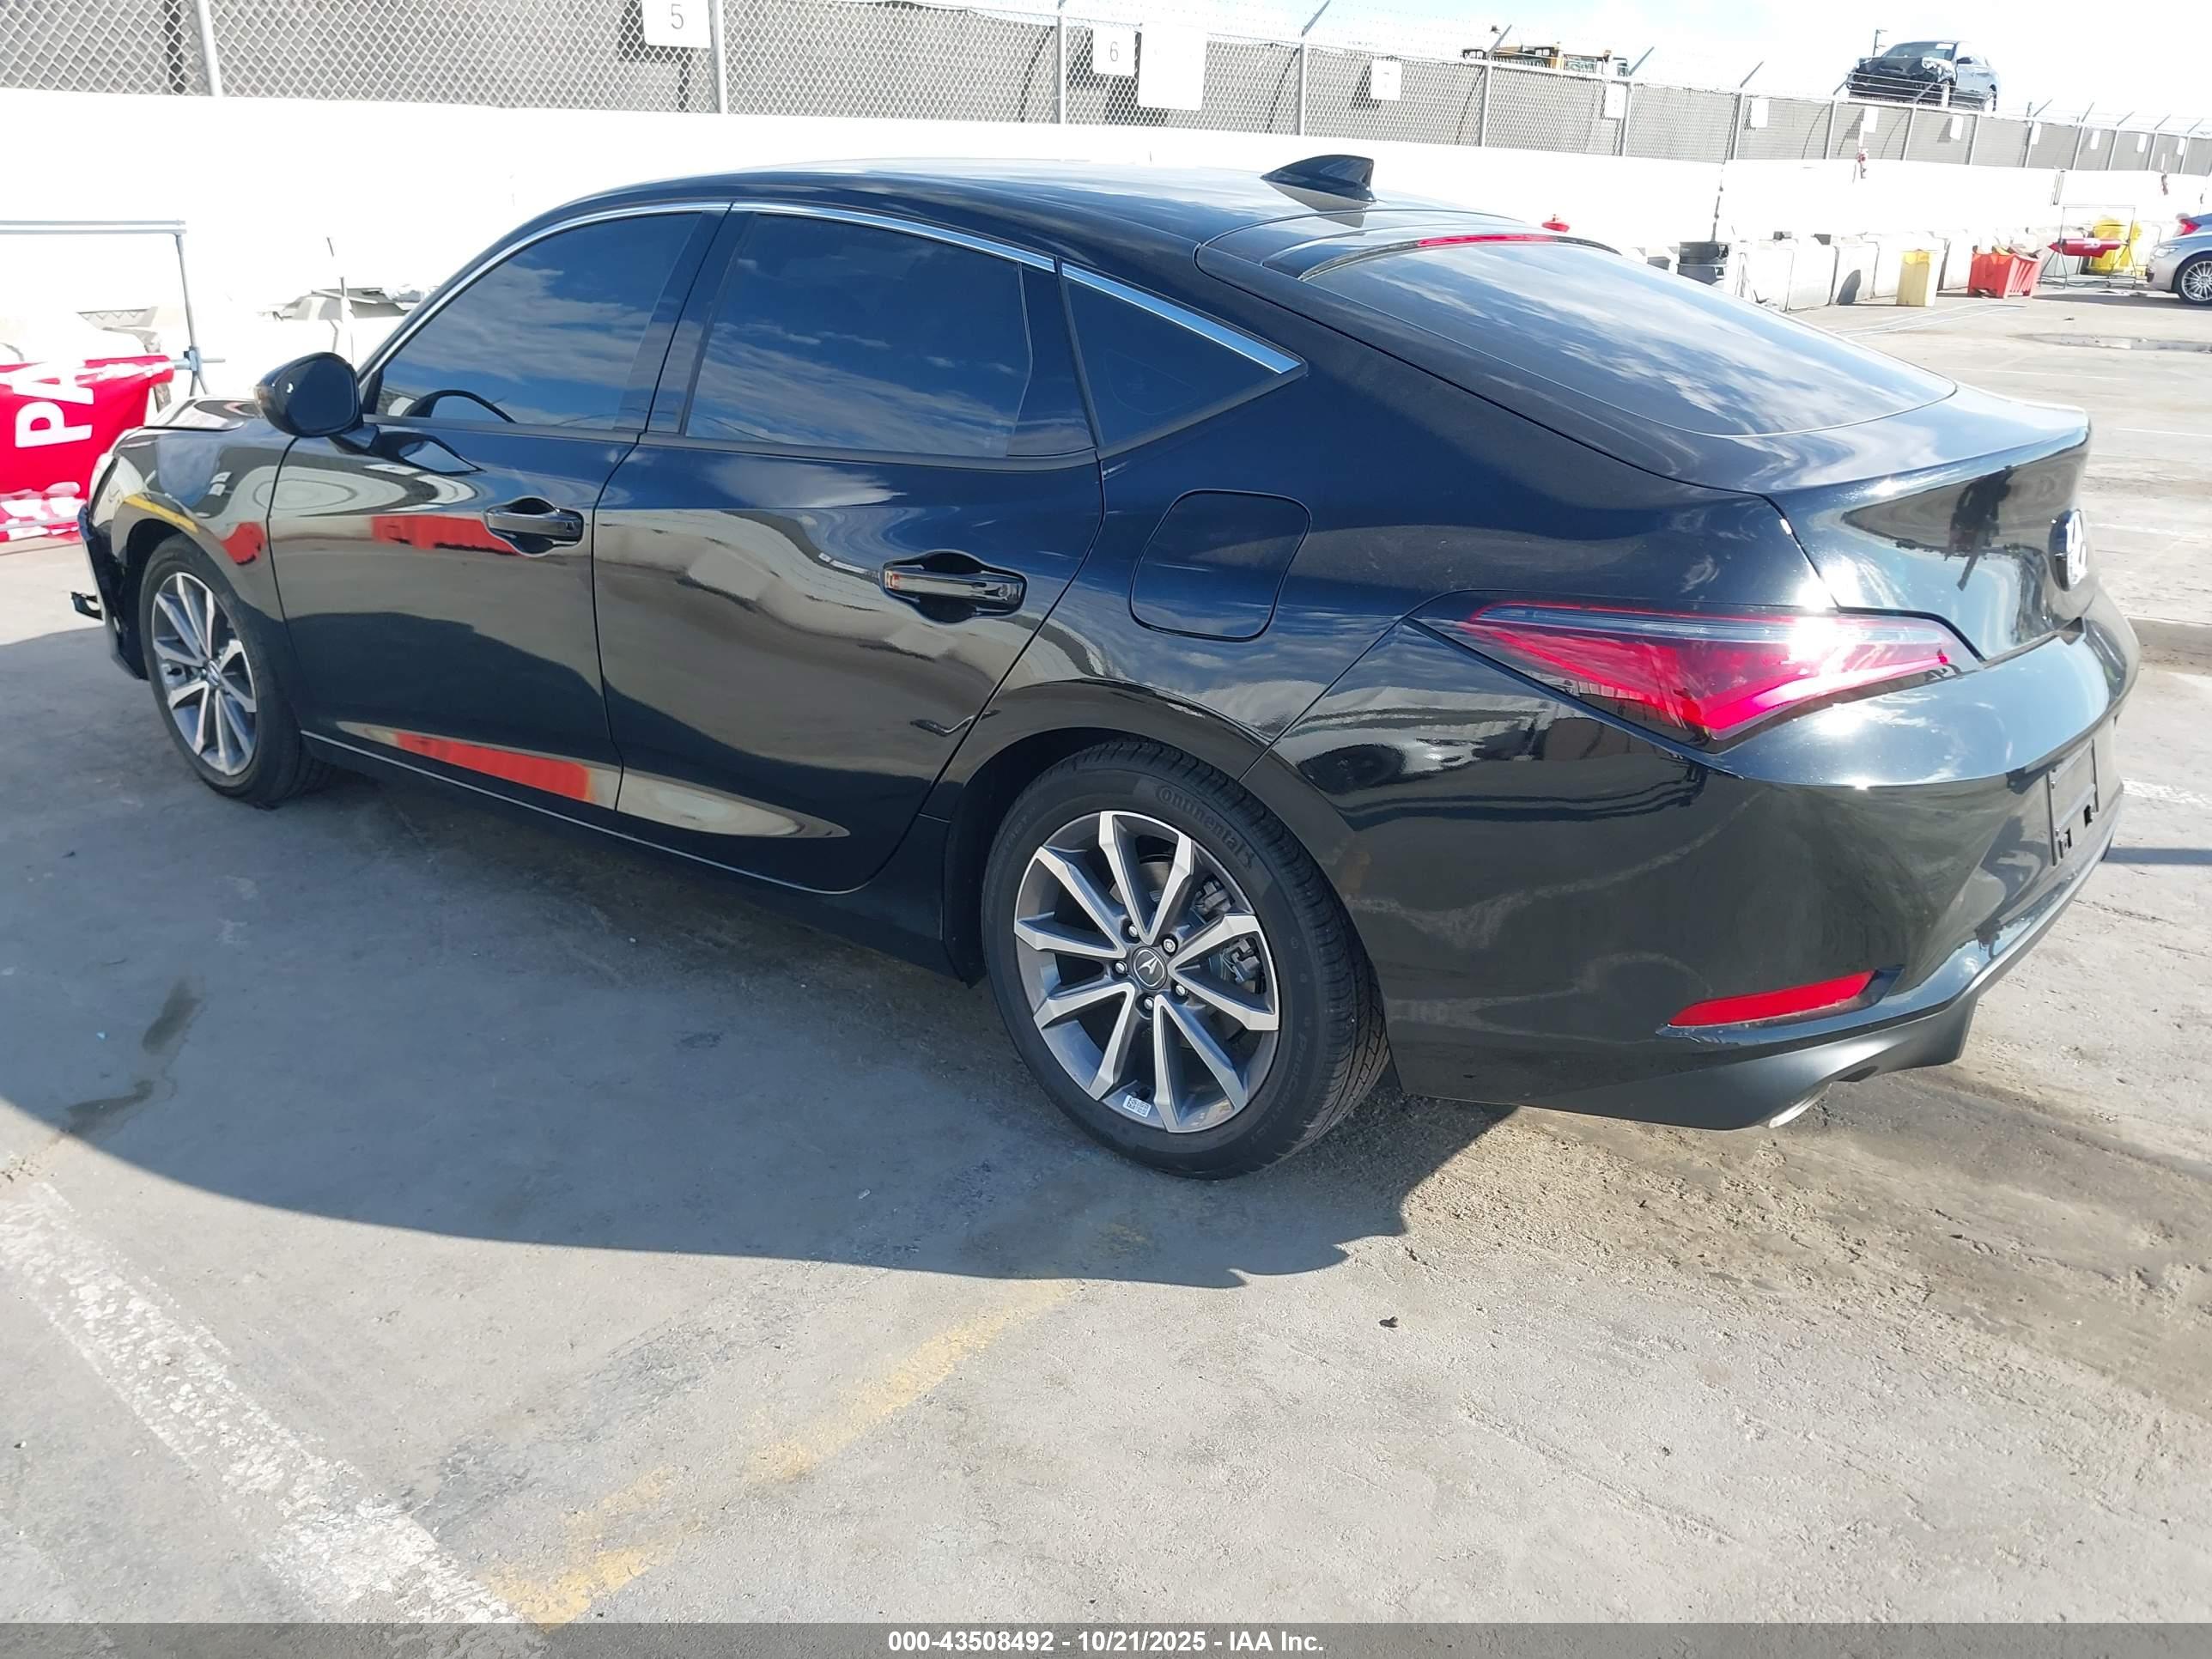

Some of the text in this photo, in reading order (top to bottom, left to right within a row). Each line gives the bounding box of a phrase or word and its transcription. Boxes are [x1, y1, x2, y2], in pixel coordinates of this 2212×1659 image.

[671, 3, 684, 30] 5
[1109, 40, 1120, 63] 6
[1155, 785, 1247, 855] Continental
